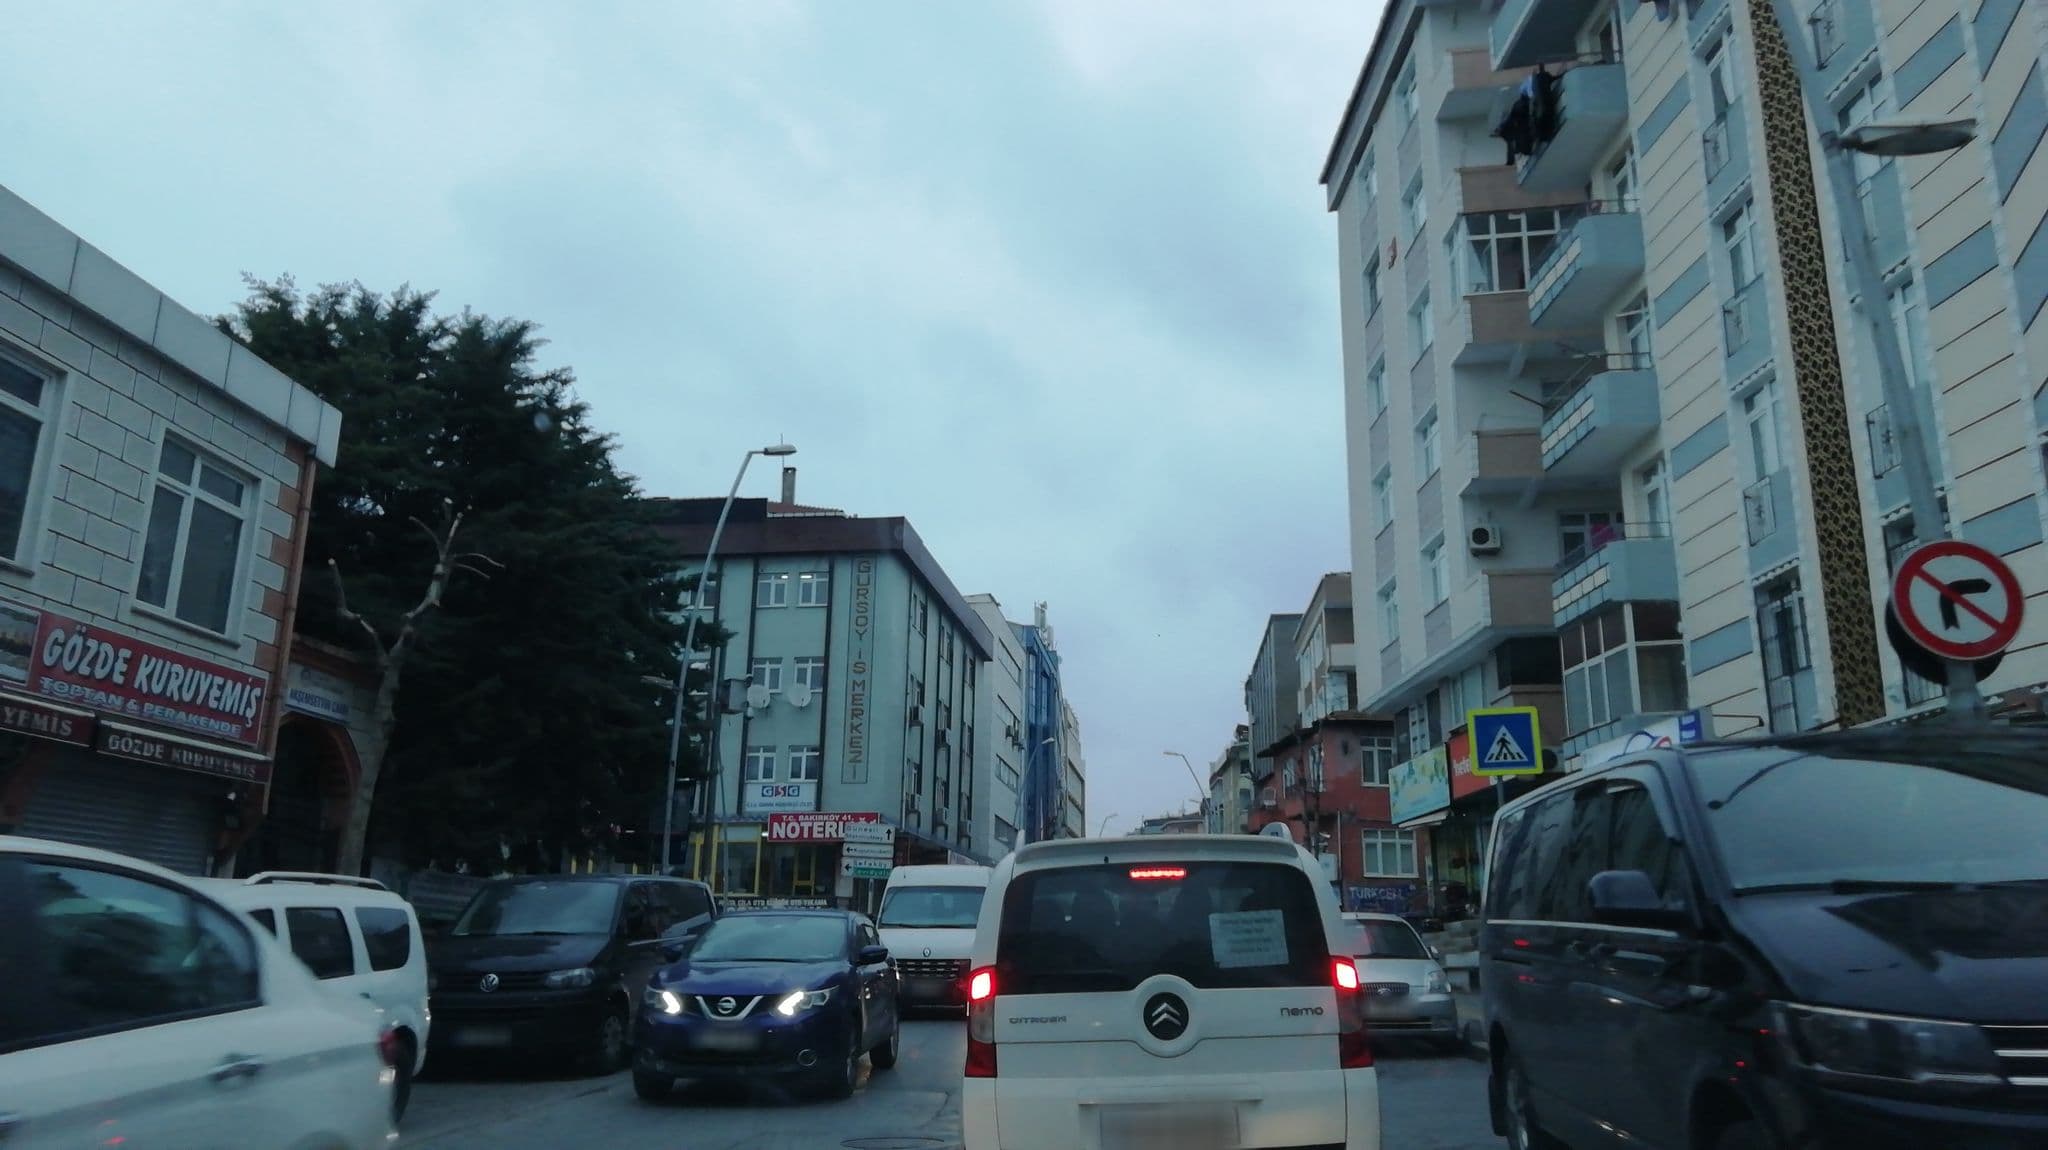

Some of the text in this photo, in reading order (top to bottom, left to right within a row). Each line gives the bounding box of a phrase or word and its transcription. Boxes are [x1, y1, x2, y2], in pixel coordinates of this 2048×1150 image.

[39, 676, 124, 710] TOPTAN
[142, 703, 243, 738] PERAKENDE
[43, 624, 262, 728] GÖZDE KURUYEMİŞ
[1280, 1006, 1325, 1017] nemo
